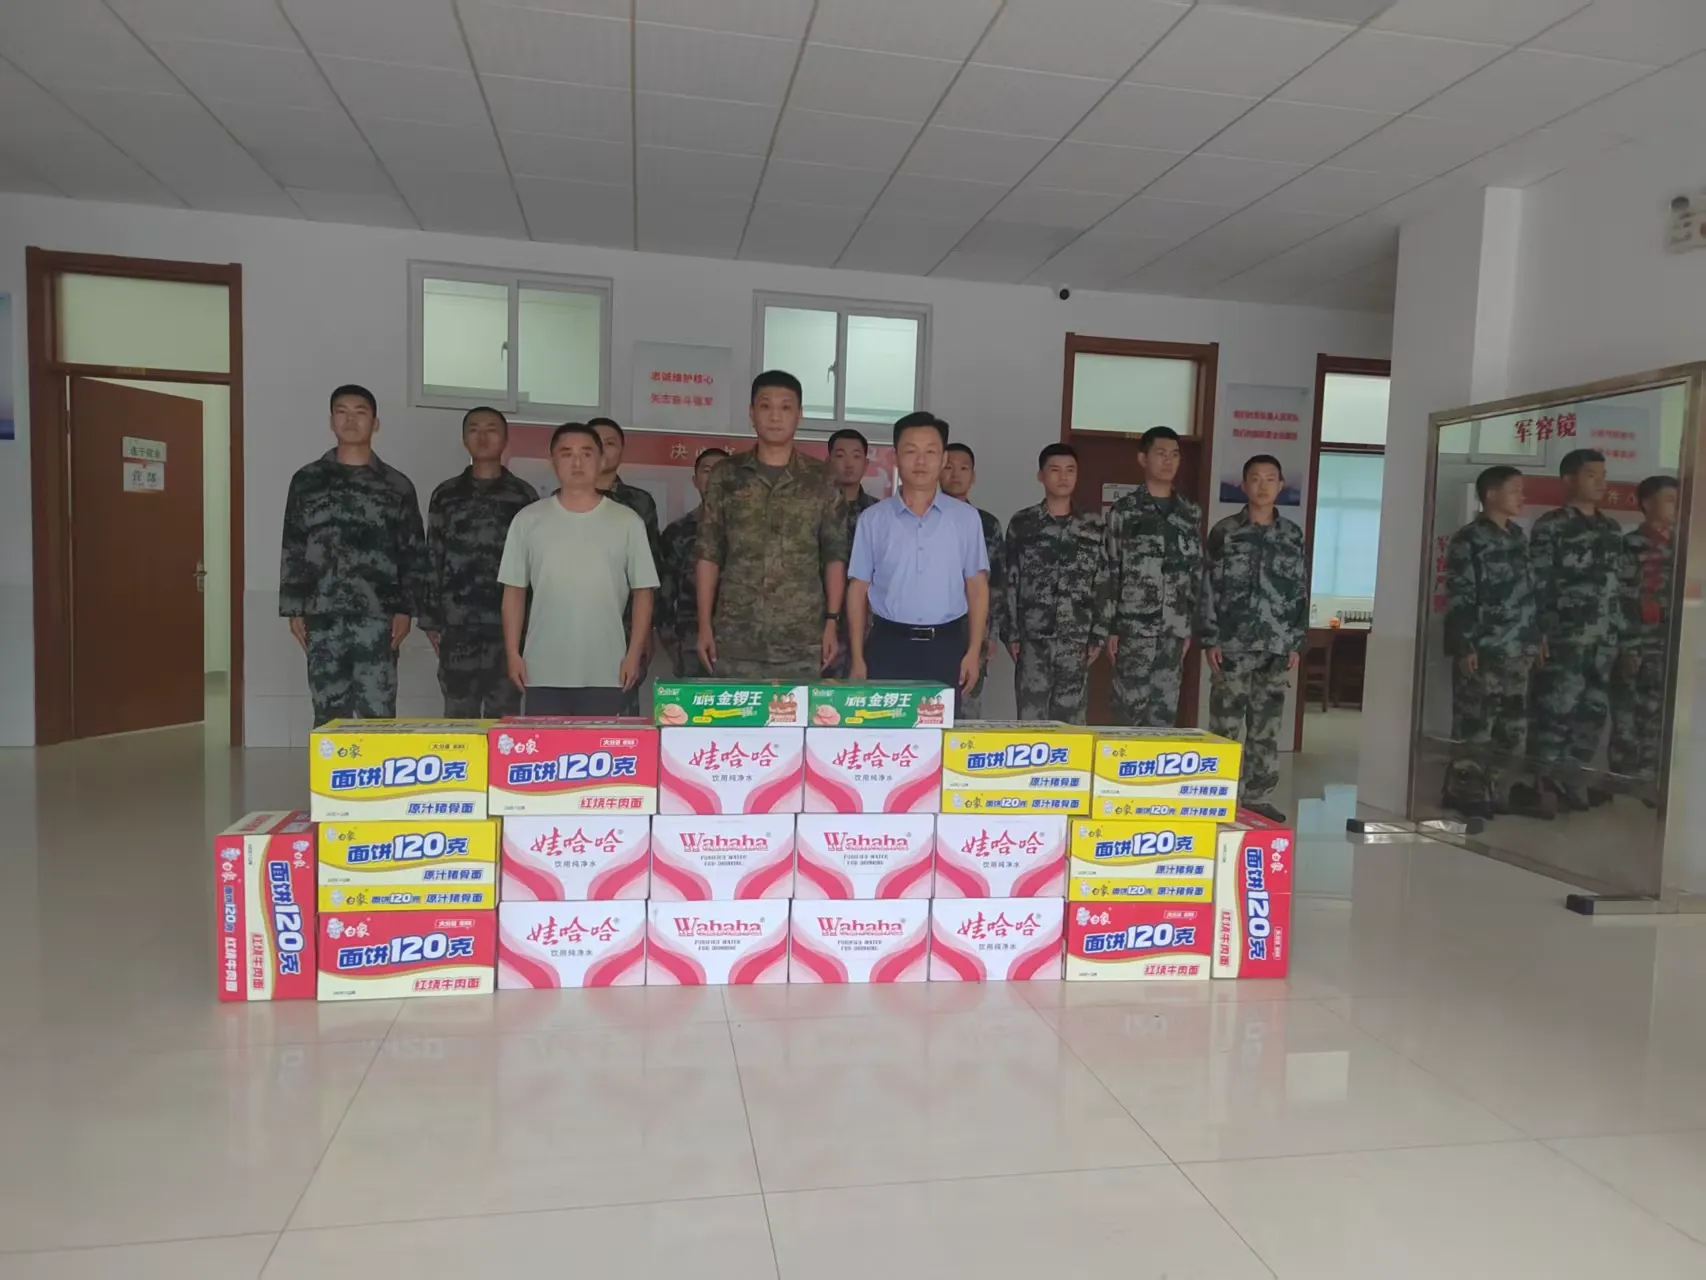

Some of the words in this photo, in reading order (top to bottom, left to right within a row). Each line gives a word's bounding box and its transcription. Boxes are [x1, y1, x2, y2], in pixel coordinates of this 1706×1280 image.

[1514, 412, 1577, 443] 军容镜
[716, 690, 764, 706] 金锣王
[867, 692, 913, 707] 金锣王
[689, 741, 779, 770] 娃哈哈
[832, 742, 919, 770] 娃哈哈
[967, 742, 1070, 770] 面饼120克
[1118, 751, 1219, 778] 面饼120克
[330, 755, 469, 791] 面饼120克
[508, 751, 637, 784] 面饼120克
[712, 774, 753, 782] 饮用纯净水
[854, 774, 893, 782] 饮用纯净水
[1030, 777, 1080, 787] 原汁猪骨面
[1180, 785, 1229, 796] 原汁猪骨面
[408, 803, 474, 814] 原汁猪骨面
[580, 797, 644, 809] 红烧牛肉面
[1032, 799, 1080, 808] 原汁猪骨面
[1180, 807, 1227, 816] 原汁猪骨面
[347, 832, 470, 864] 面饼120克
[530, 827, 624, 856] 娃哈哈
[679, 832, 768, 852] Wahaha
[824, 832, 909, 851] Wahaha
[961, 829, 1044, 857] 娃哈哈
[1095, 830, 1193, 859] 面饼120克
[554, 860, 597, 868] 饮用纯净水
[1155, 865, 1204, 875] 原汁猪骨面
[423, 869, 483, 880] 原汁猪骨面
[425, 893, 483, 904] 原汁猪骨面
[1157, 887, 1204, 896] 原汁猪骨面
[1245, 846, 1271, 960] 面饼120克
[268, 860, 304, 974] 面饼120克
[673, 917, 762, 936] Wahaha
[817, 917, 904, 936] Wahaha
[957, 912, 1041, 940] 娃哈哈
[527, 916, 620, 945] 娃哈哈
[1083, 922, 1196, 954] 面饼120克
[338, 933, 474, 969] 面饼120克
[225, 937, 238, 992] 红烧牛肉面
[1144, 964, 1200, 976] 红烧牛肉面
[413, 978, 480, 991] 红烧牛肉面
